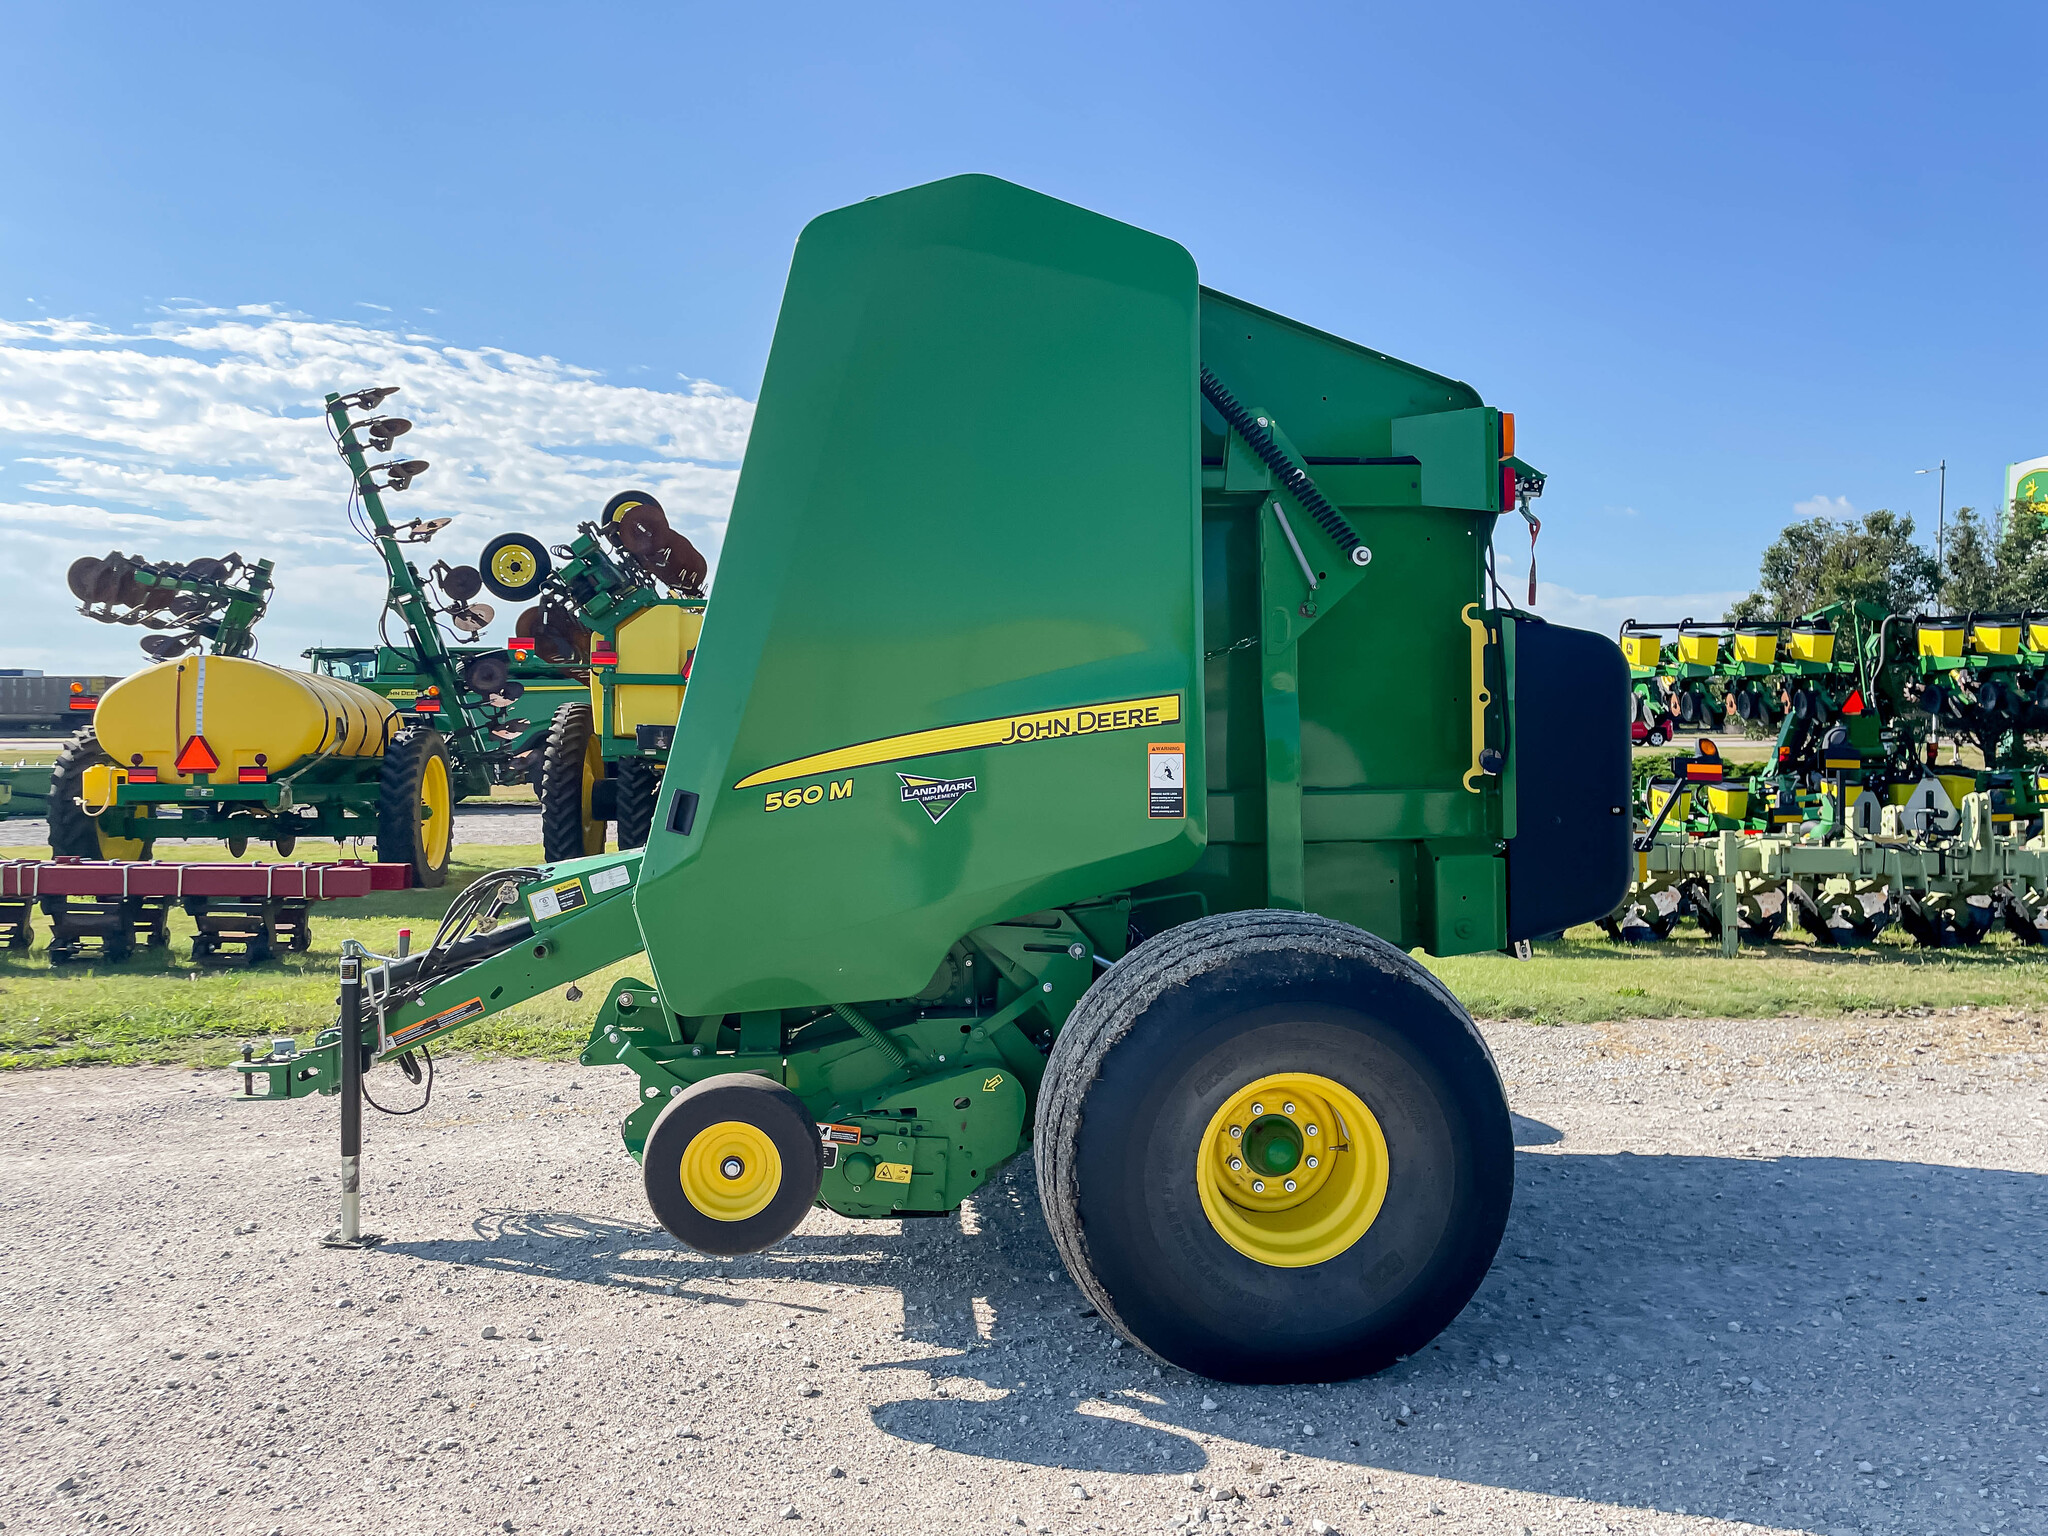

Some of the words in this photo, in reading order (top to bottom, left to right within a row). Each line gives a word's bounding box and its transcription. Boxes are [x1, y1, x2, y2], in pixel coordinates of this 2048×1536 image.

[1002, 717, 1070, 742] JOHN
[1077, 706, 1160, 731] DEERE
[764, 785, 824, 812] 560
[829, 778, 854, 801] M
[904, 782, 973, 798] LANDMARK
[922, 792, 959, 801] IMPLEMENT
